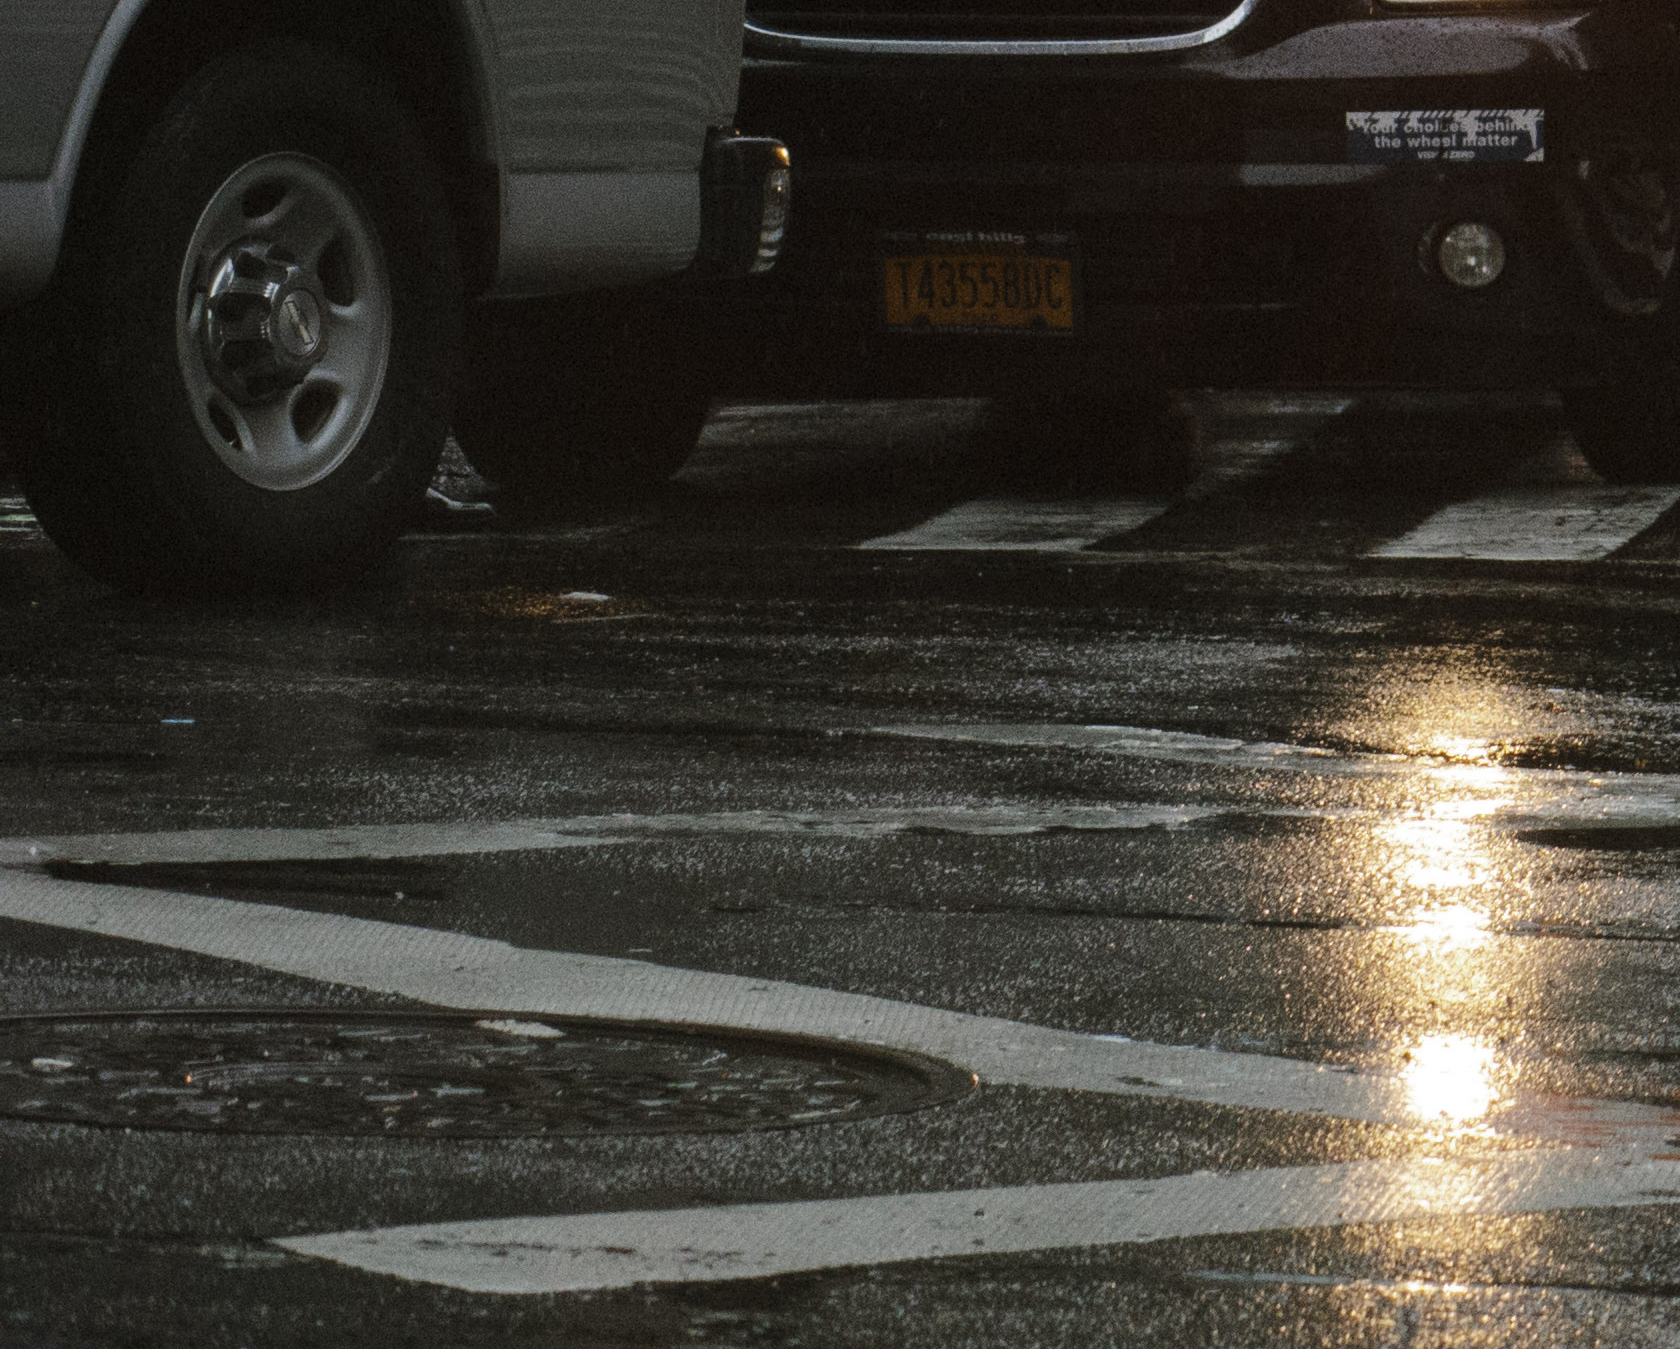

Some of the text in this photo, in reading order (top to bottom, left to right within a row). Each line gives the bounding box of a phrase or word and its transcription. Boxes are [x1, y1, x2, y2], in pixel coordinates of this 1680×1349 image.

[1374, 133, 1520, 149] the wheel matter
